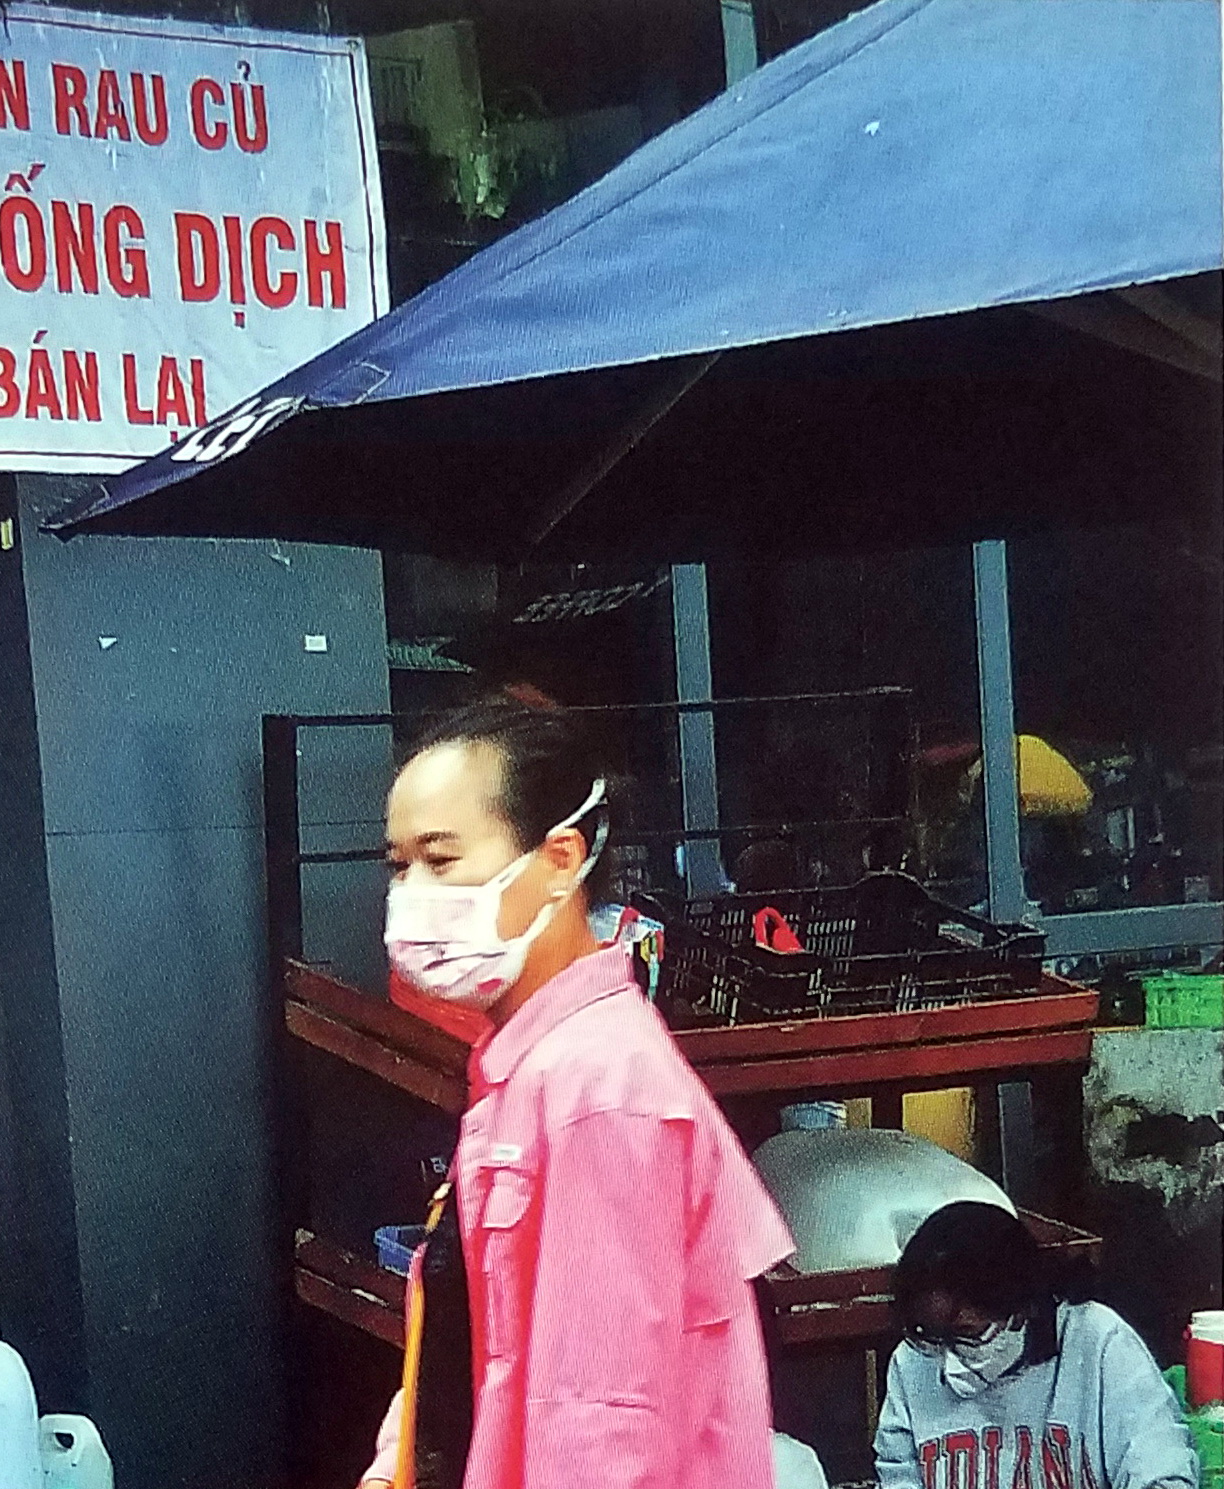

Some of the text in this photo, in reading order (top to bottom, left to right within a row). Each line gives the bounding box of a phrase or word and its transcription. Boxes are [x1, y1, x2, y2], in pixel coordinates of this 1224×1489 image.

[51, 62, 170, 147] RAU
[190, 60, 270, 153] CỦ
[173, 211, 347, 329] DỊCH
